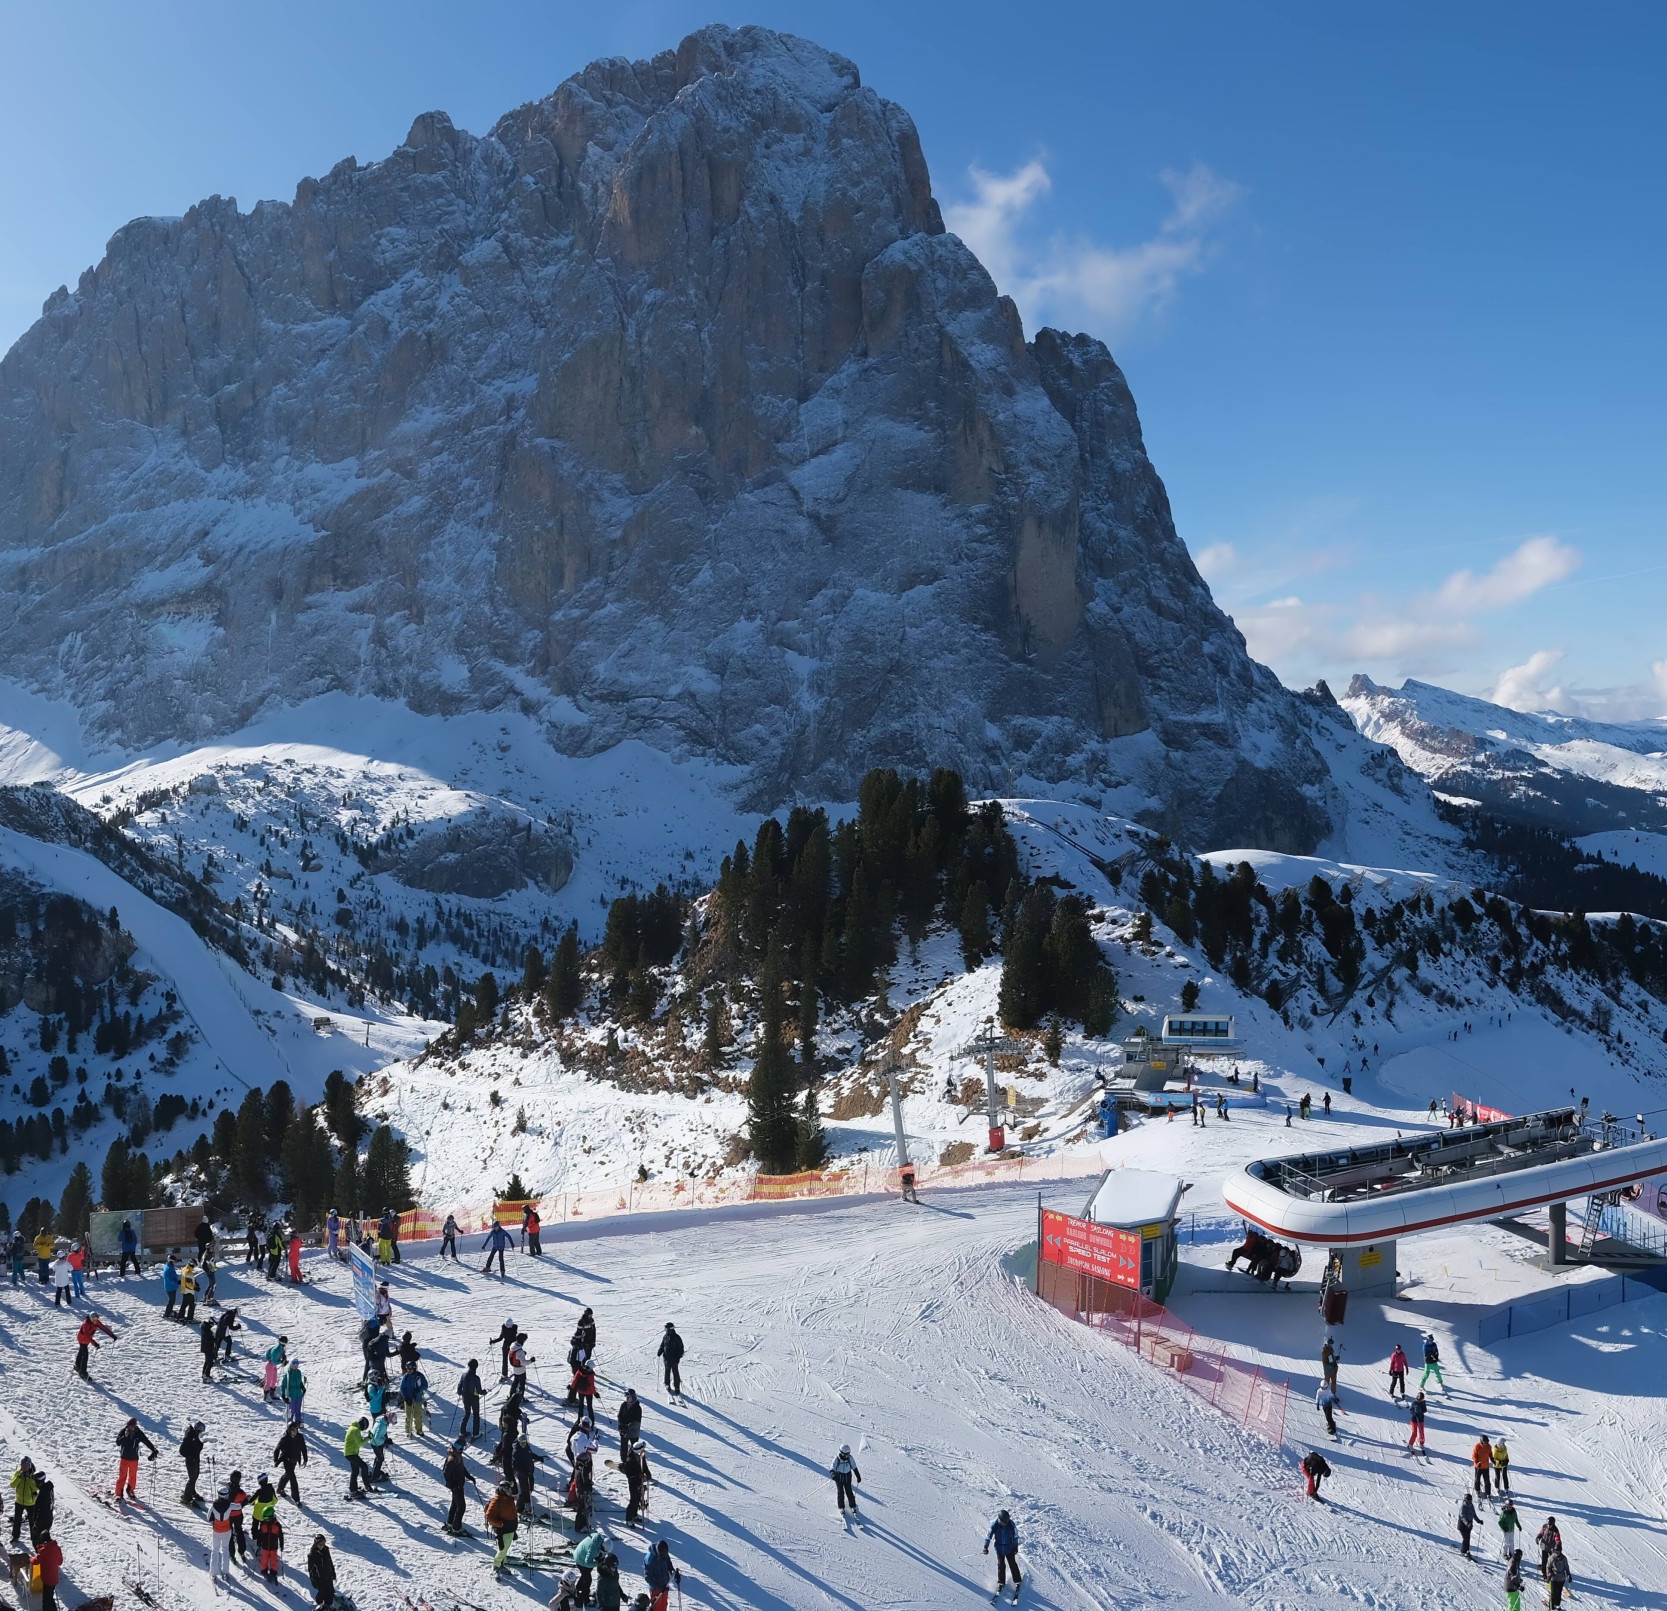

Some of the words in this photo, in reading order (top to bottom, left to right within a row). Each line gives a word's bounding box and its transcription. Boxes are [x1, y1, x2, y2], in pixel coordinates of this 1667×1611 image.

[1090, 1225, 1114, 1238] SASLONG
[1063, 1237, 1092, 1251] PARALLEL
[1093, 1247, 1116, 1258] SLALOM
[1068, 1246, 1091, 1257] SPEED
[1093, 1253, 1111, 1263] TEST
